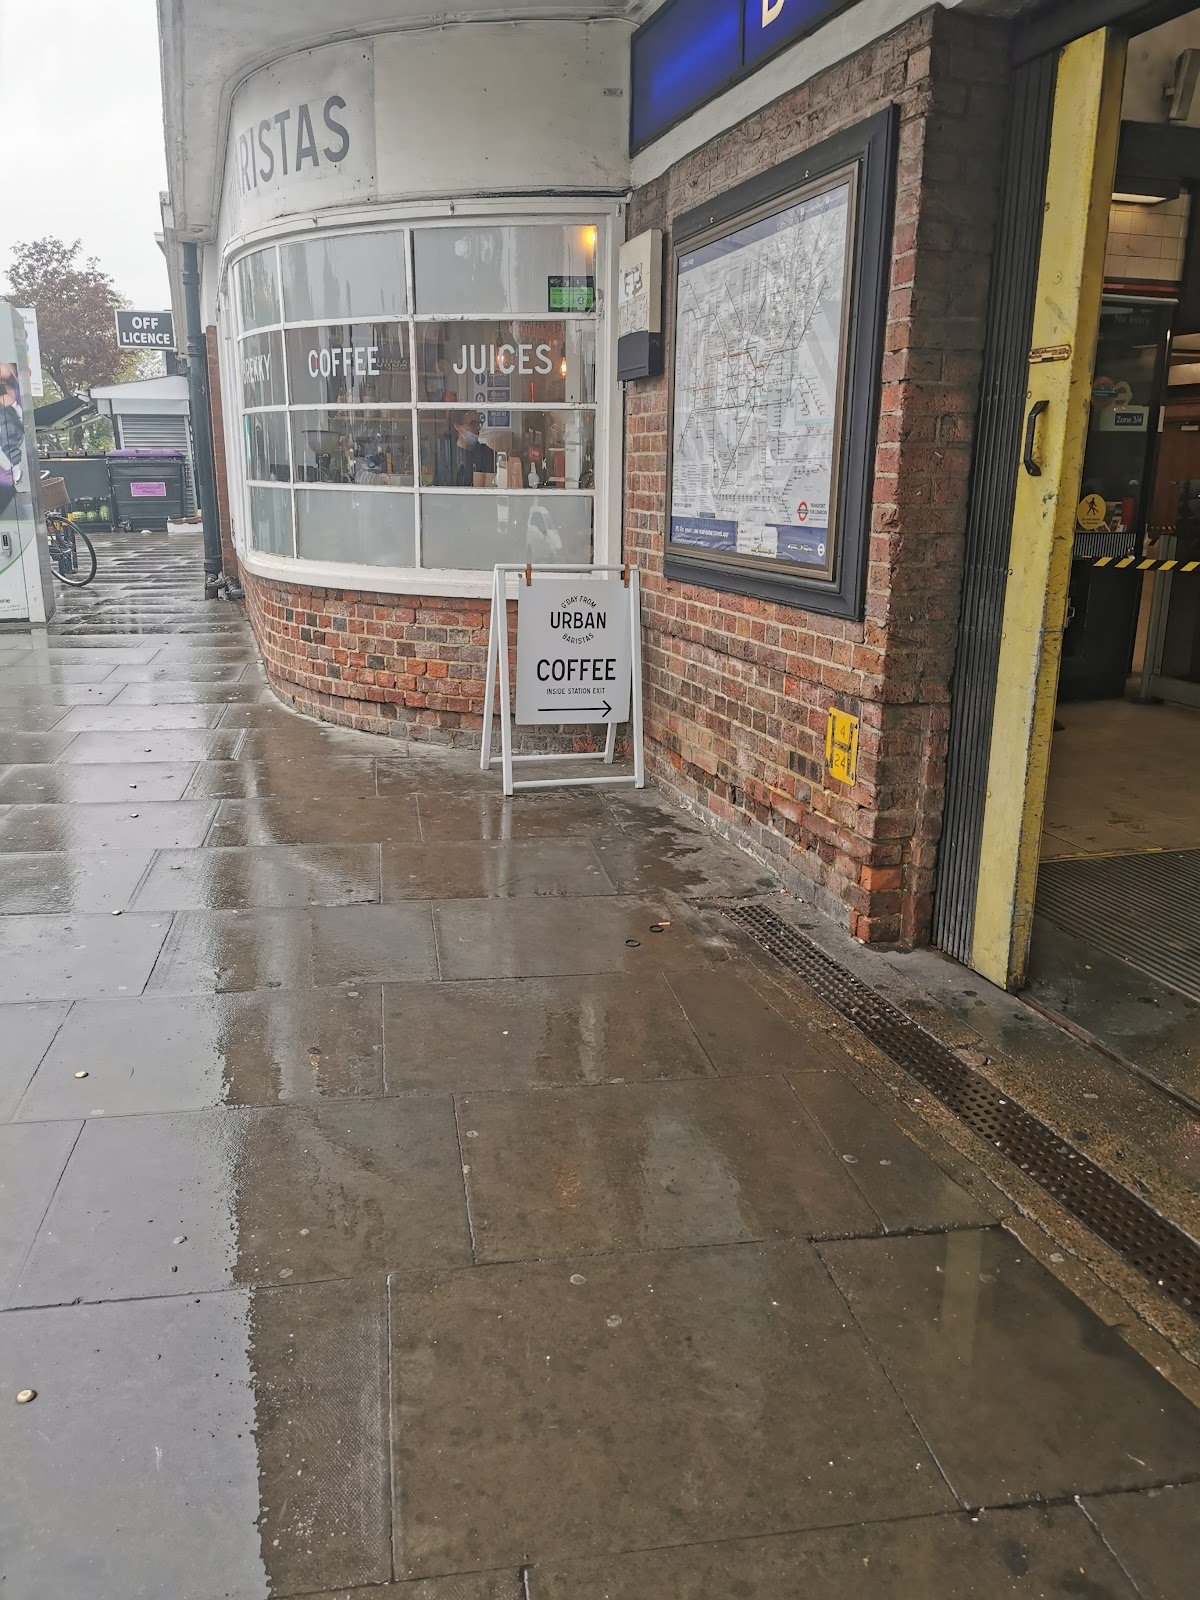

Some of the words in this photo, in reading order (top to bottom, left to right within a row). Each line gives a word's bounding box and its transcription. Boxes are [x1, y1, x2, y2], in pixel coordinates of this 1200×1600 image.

[131, 316, 159, 330] OFF
[122, 331, 171, 345] LICENCE
[308, 346, 380, 378] COFFEE
[452, 343, 553, 375] JUICES
[560, 595, 578, 609] G'DAY
[579, 595, 597, 609] FROM
[550, 611, 606, 630] URBAN
[561, 632, 594, 645] BARISTAS
[536, 658, 617, 682] COFFEE
[546, 687, 565, 695] INSIDE
[567, 687, 591, 695] STATION
[592, 687, 606, 695] EXIT
[840, 725, 846, 738] 4
[834, 753, 846, 771] 24
